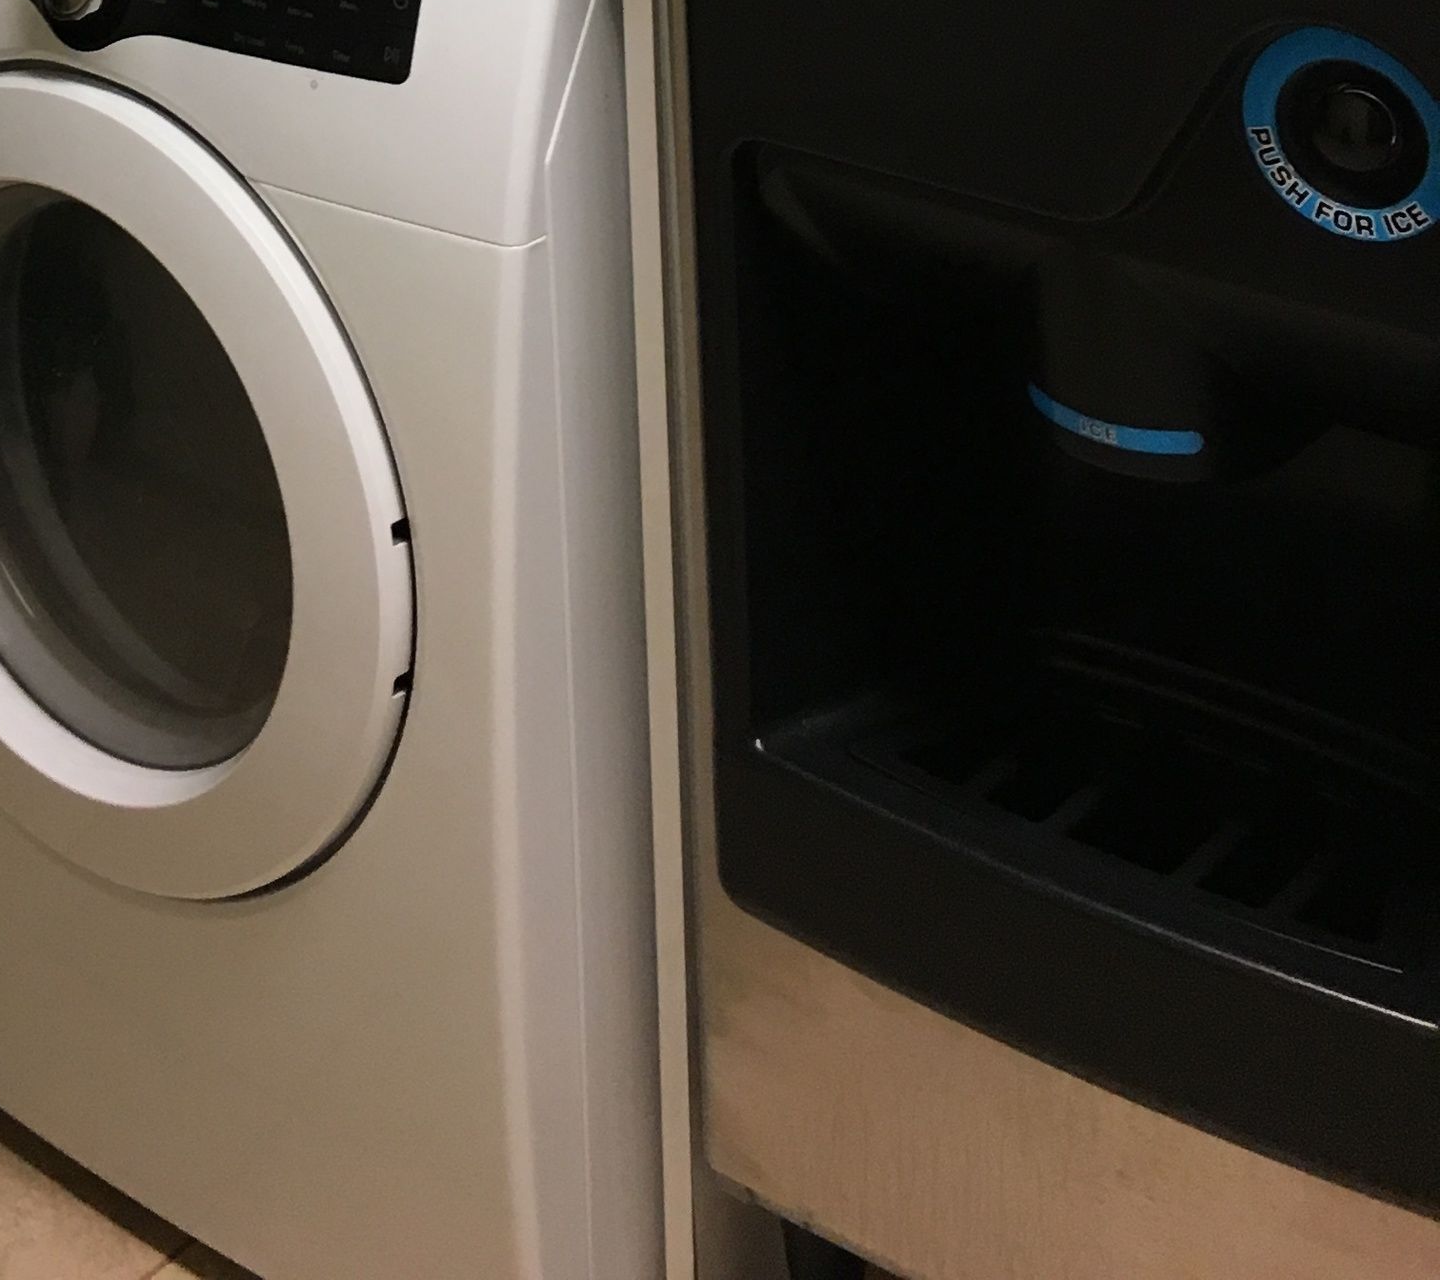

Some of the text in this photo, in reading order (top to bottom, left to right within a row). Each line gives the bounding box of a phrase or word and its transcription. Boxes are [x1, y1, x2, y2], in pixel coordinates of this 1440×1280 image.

[1250, 127, 1430, 236] PUSH FOR ICE
